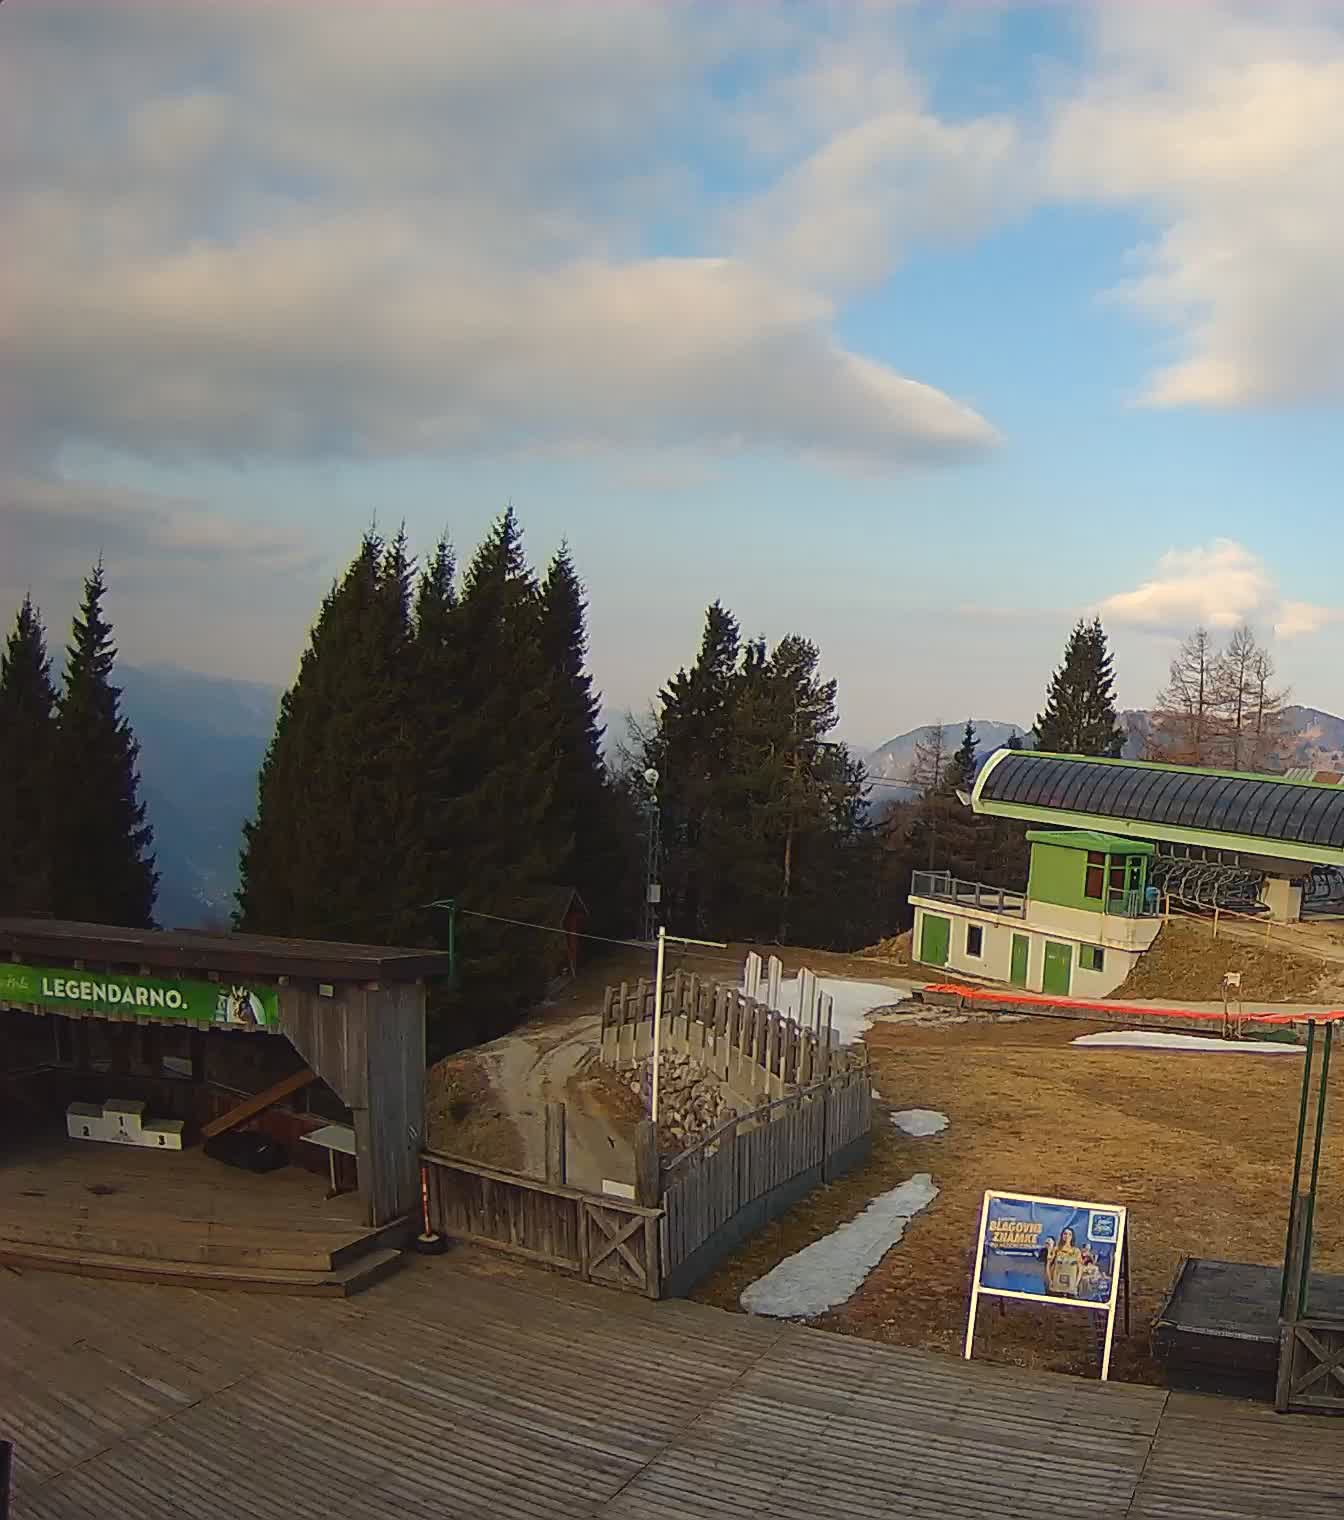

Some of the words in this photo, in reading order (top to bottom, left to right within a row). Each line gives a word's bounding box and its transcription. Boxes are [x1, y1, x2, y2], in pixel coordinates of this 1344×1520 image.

[42, 977, 188, 1009] LEGENDARNO.
[119, 1115, 124, 1126] 1
[82, 1126, 90, 1136] 2
[158, 1135, 166, 1145] 3
[992, 1231, 1038, 1244] ZNAMKE
